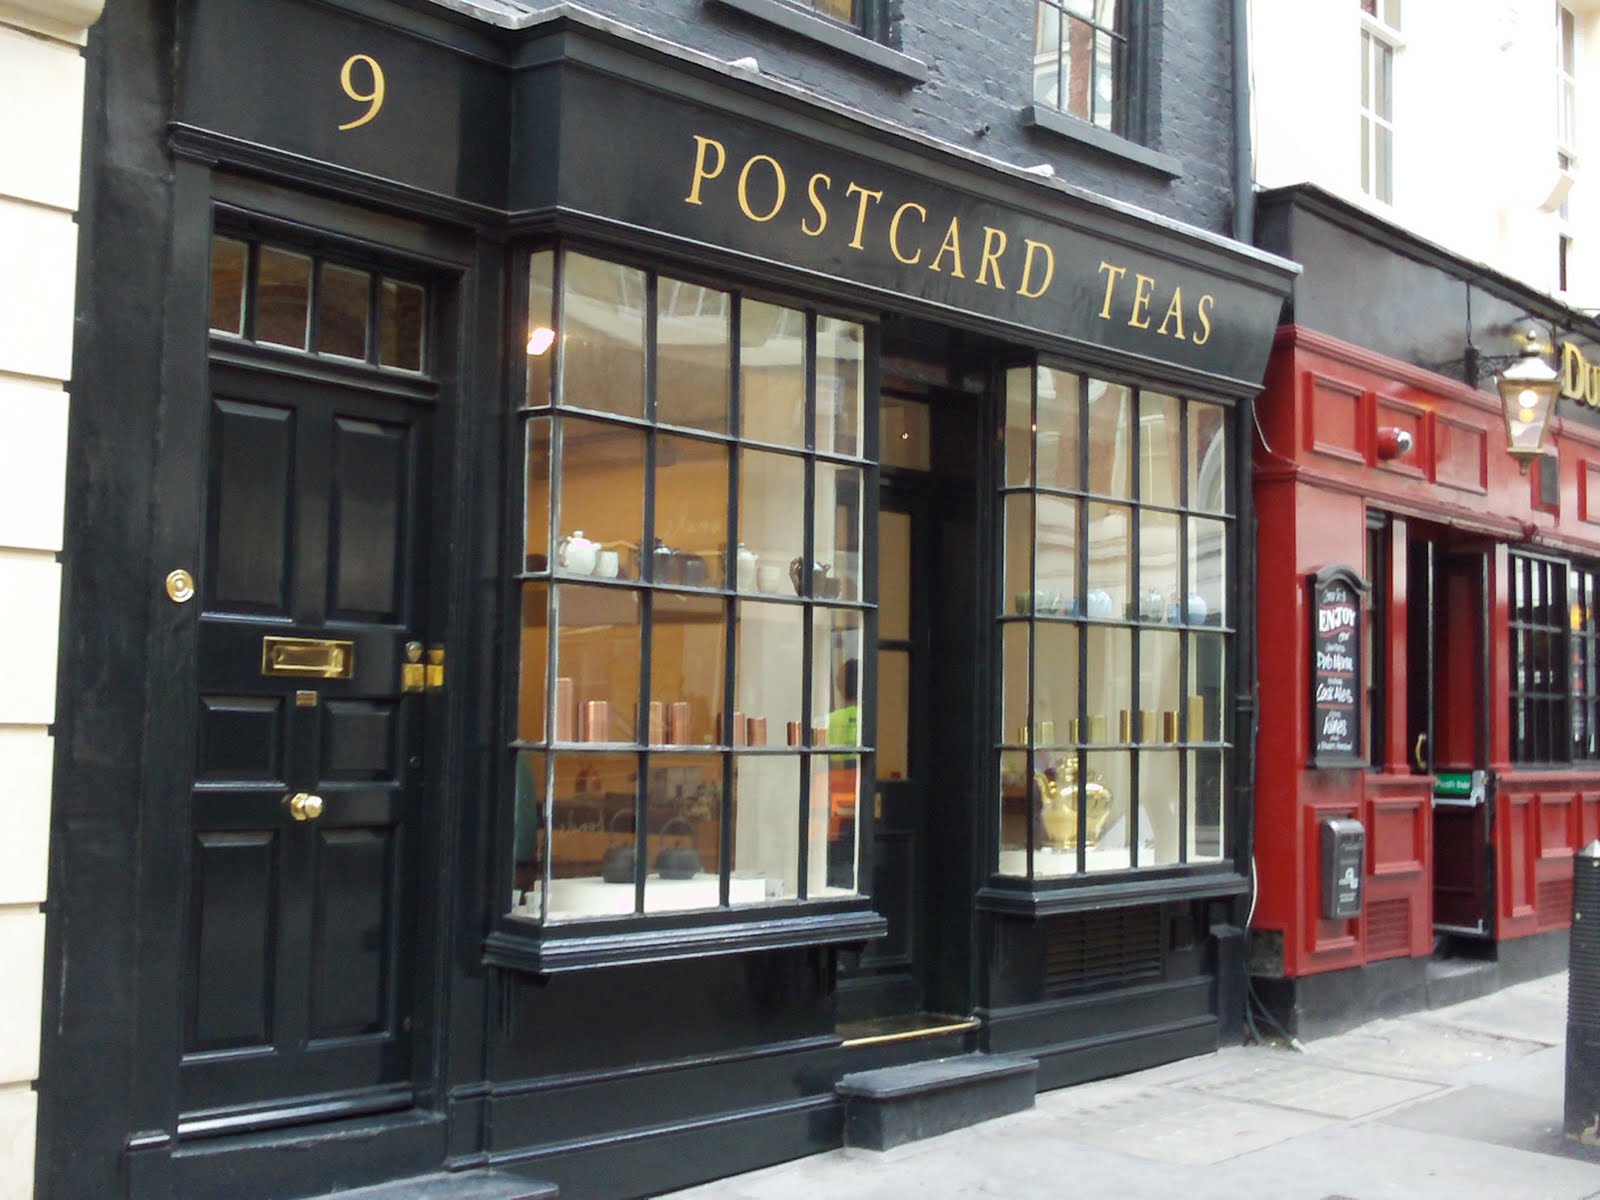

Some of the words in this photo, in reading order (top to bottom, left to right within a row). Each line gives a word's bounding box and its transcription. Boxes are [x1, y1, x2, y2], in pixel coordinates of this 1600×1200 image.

[339, 54, 385, 130] 9
[685, 135, 1055, 299] POSTCARD
[1098, 261, 1215, 345] TEAS
[1319, 607, 1356, 633] ENJOY
